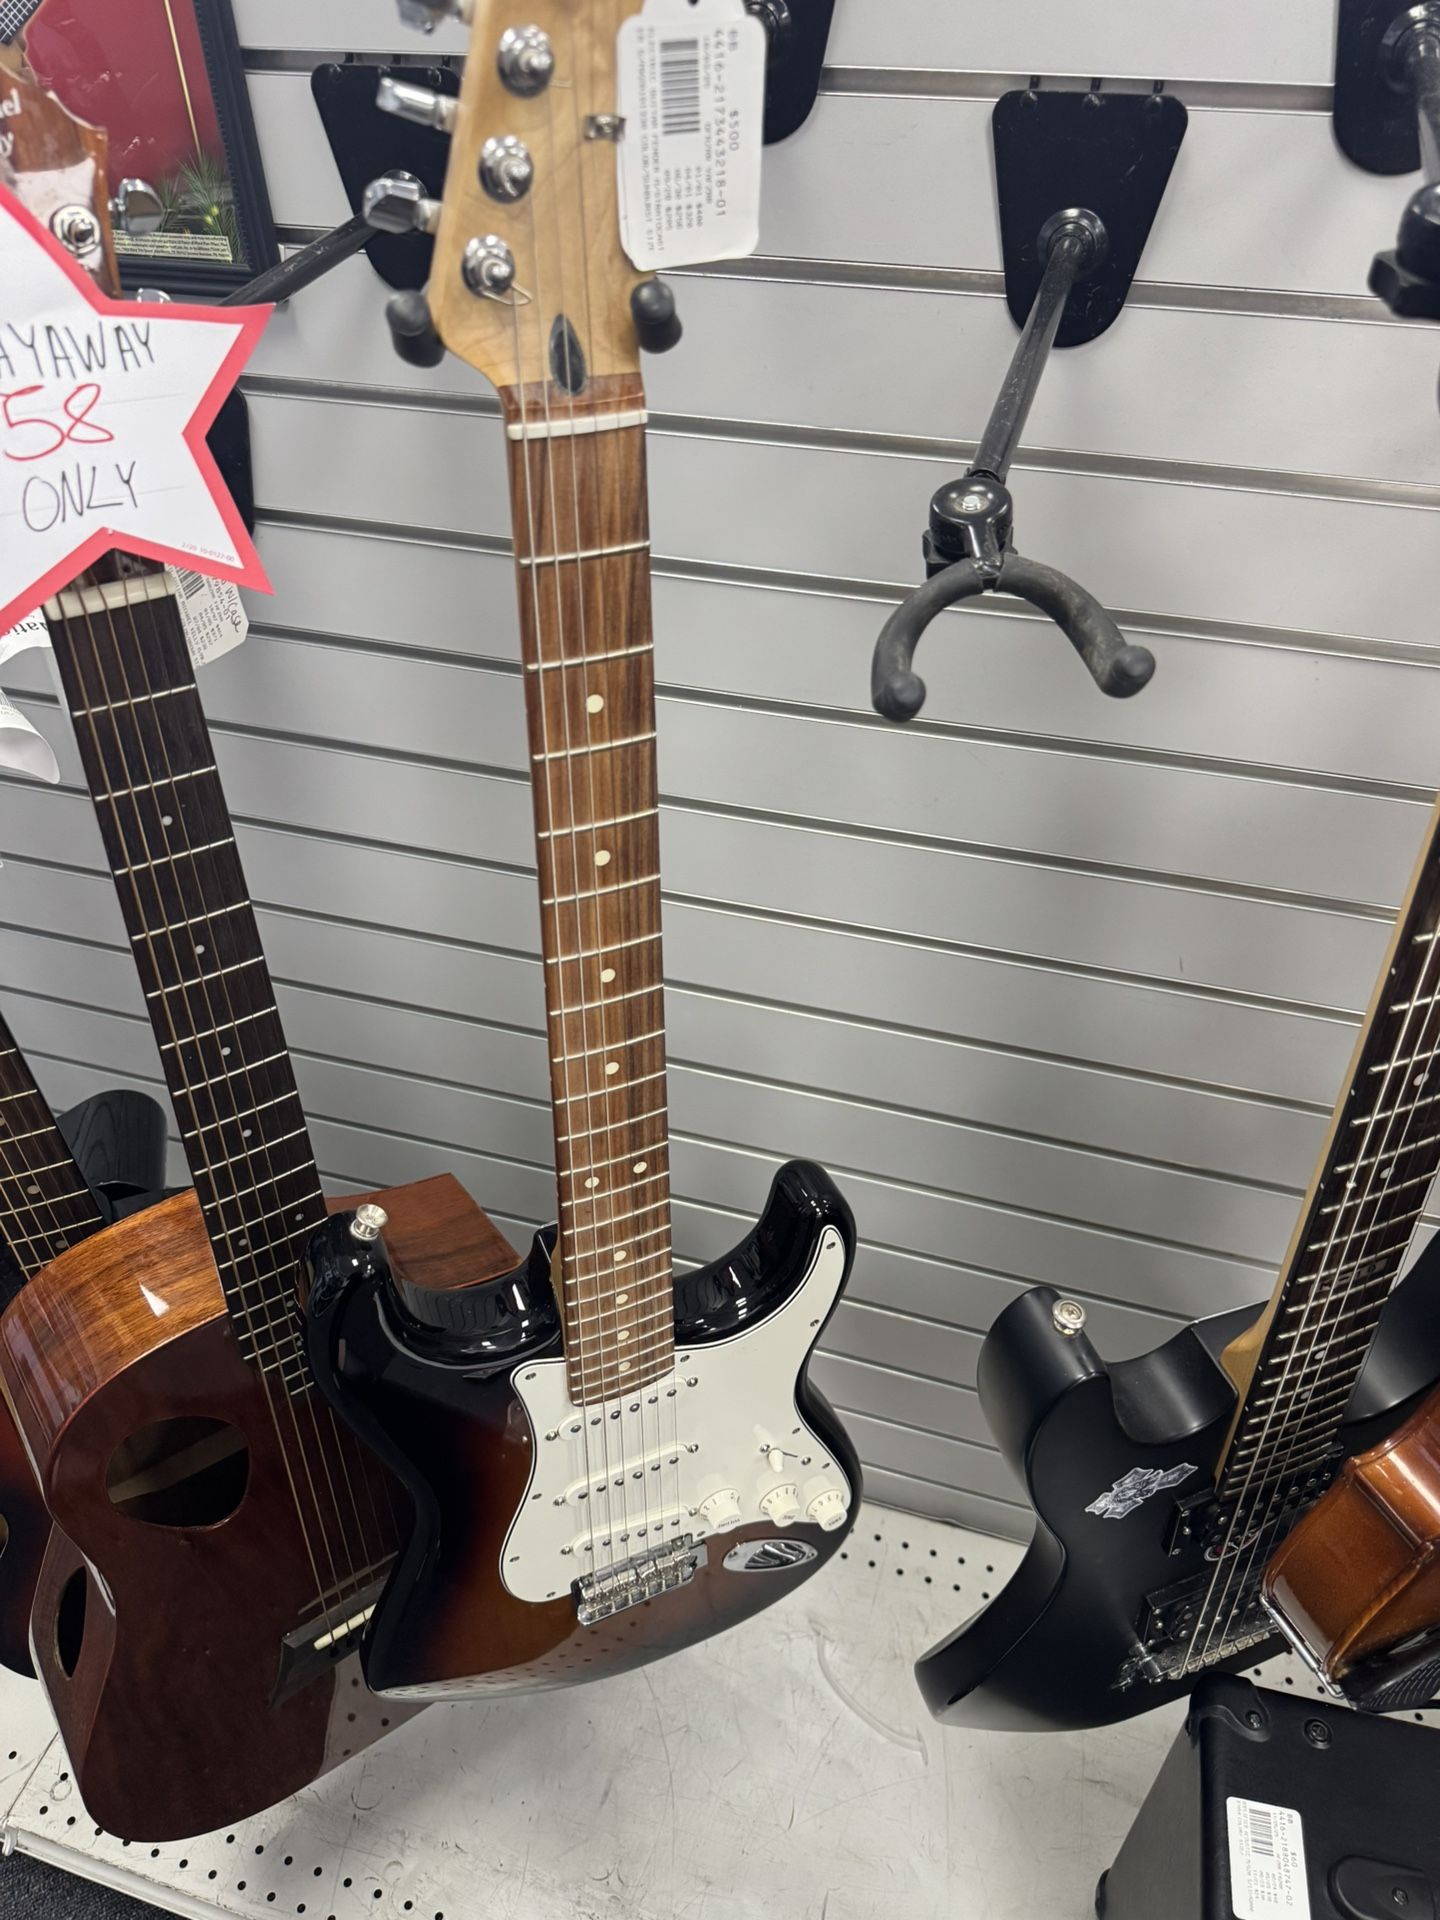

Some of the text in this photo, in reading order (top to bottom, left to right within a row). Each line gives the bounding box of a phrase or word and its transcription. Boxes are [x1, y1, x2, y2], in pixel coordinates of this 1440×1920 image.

[728, 109, 740, 152] $500
[22, 460, 138, 533] ONLY
[1290, 1851, 1298, 1868] $60
